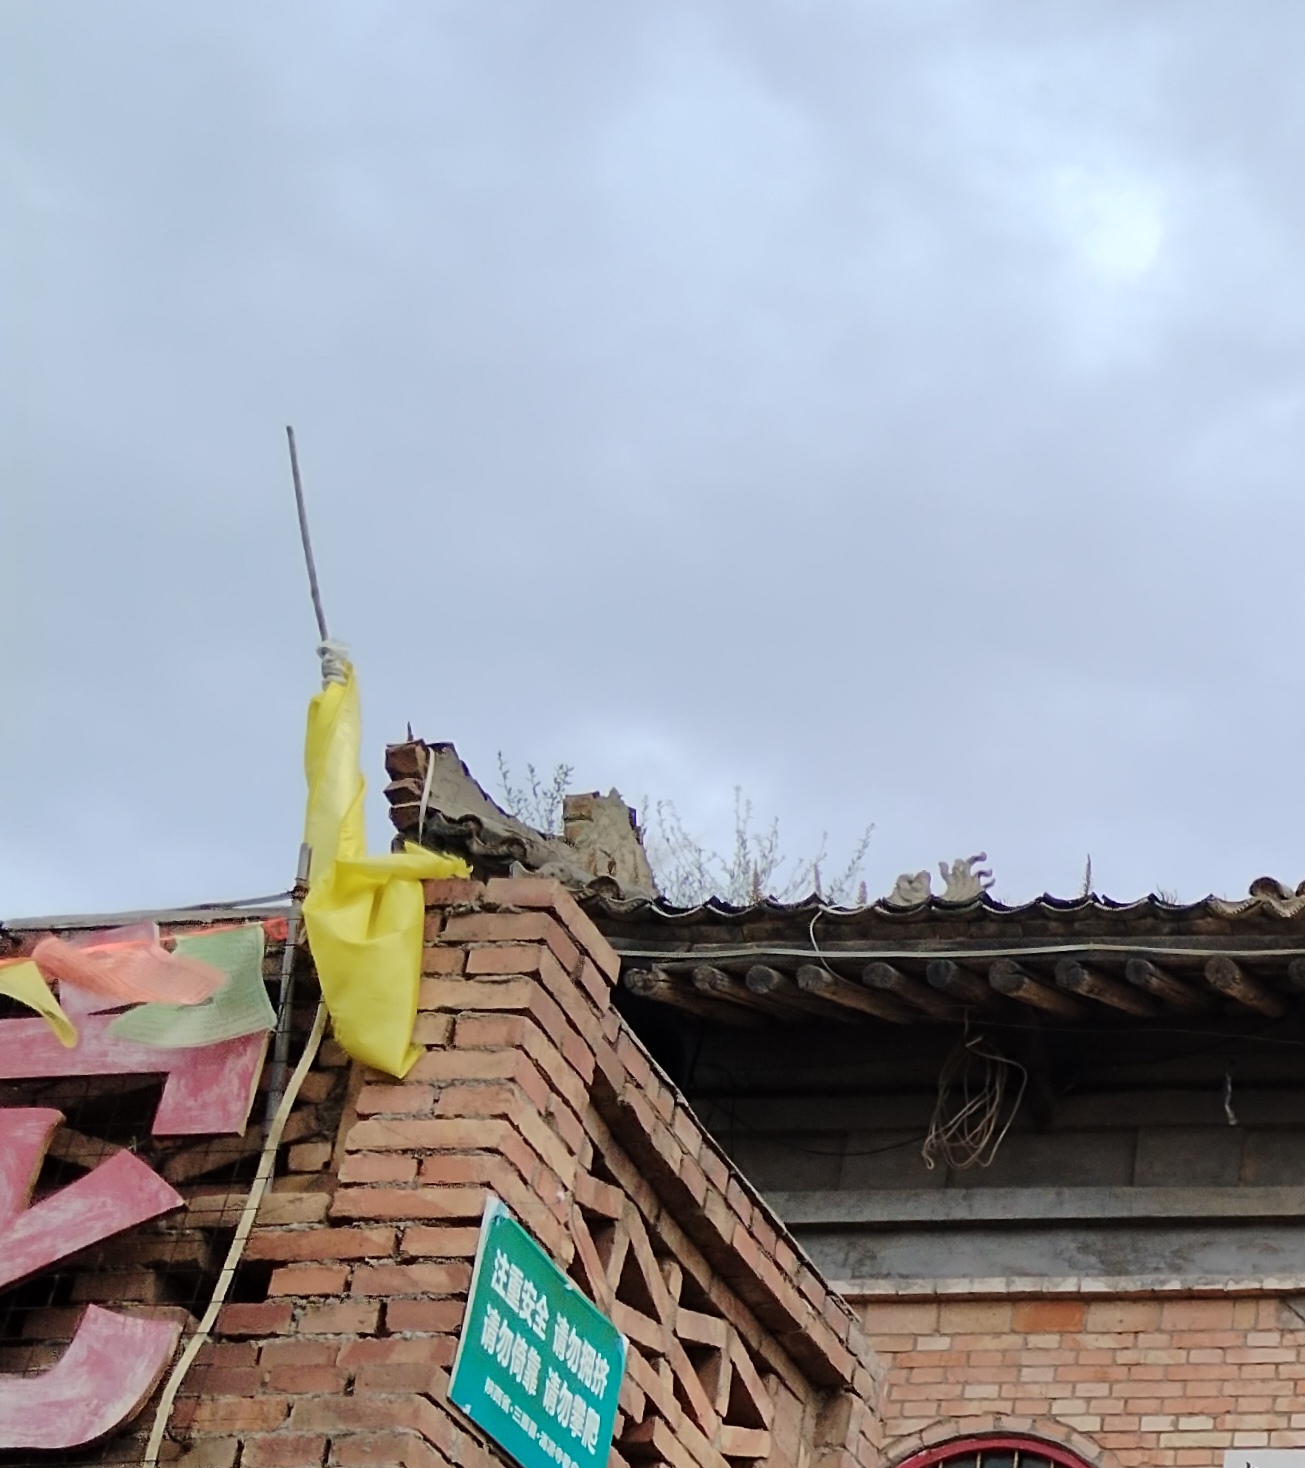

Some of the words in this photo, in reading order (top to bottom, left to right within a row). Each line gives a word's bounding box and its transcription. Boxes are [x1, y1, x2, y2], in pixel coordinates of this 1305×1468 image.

[480, 1303, 542, 1396] 请勿倚靠
[542, 1367, 601, 1455] 请勿攀爬
[552, 1312, 610, 1400] 请勿拥挤
